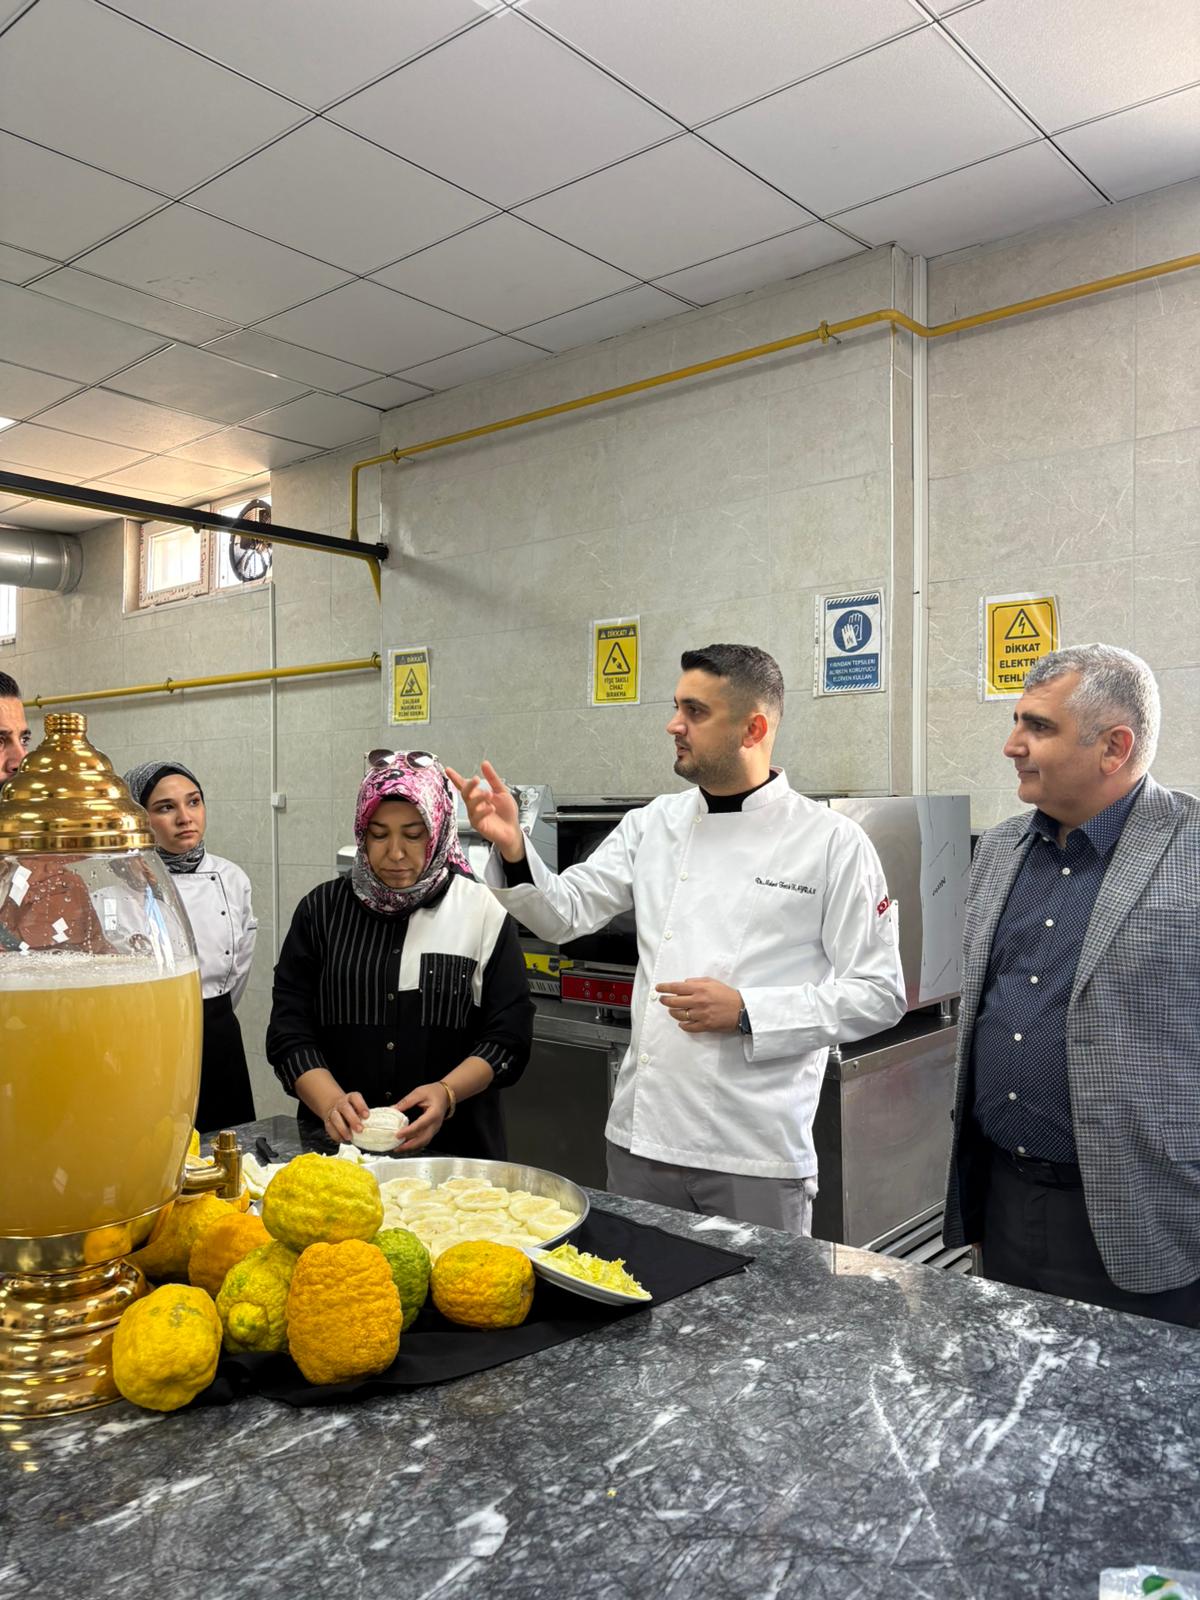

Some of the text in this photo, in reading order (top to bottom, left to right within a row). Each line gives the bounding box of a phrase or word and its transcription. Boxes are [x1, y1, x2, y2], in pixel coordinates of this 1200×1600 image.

[1005, 643, 1040, 654] DİKKAT
[999, 656, 1039, 668] ELEKTR
[998, 671, 1025, 683] TEHLİ
